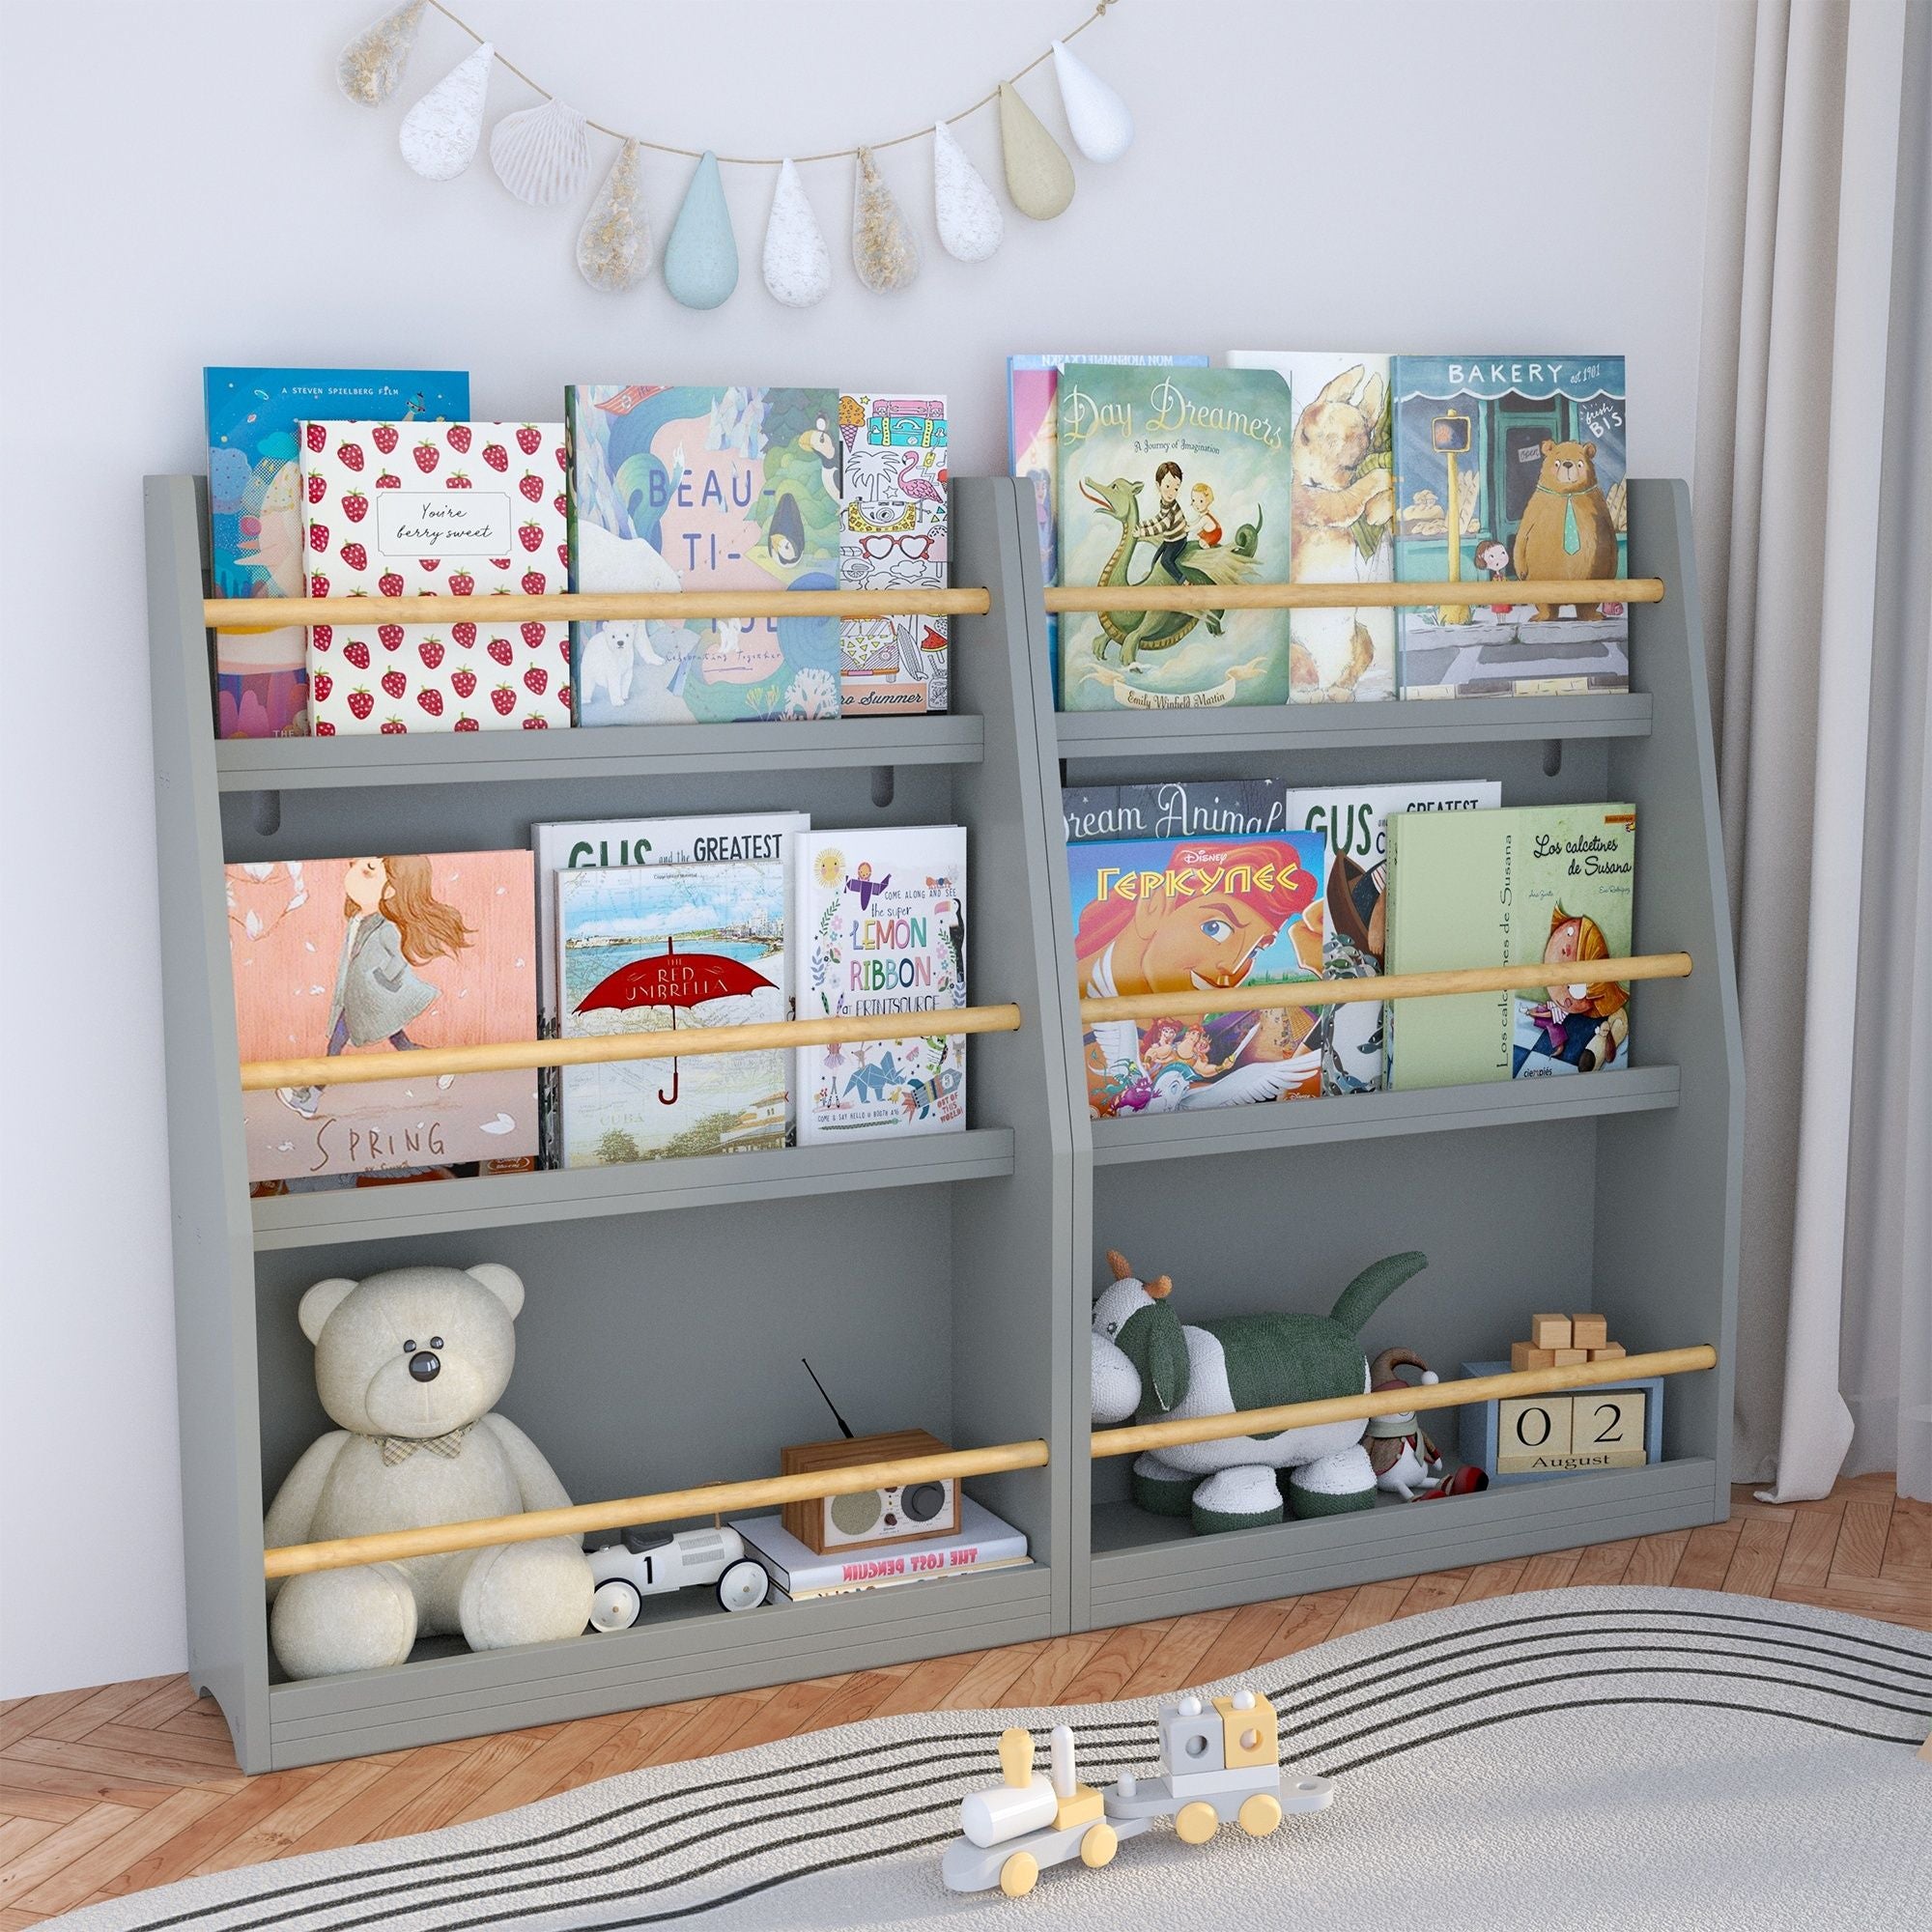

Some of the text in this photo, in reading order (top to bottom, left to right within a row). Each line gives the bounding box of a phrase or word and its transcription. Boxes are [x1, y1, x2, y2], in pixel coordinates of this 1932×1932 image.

[1449, 363, 1563, 384] BAKERY
[292, 386, 324, 395] STEVEN
[327, 386, 374, 396] SPIELBERG
[378, 386, 399, 395] FILM
[1063, 376, 1284, 451] Day Dreamers
[1585, 403, 1614, 425] fresh
[1589, 412, 1624, 440] BIS
[1144, 439, 1171, 453] Journey
[1171, 439, 1179, 449] of
[1180, 439, 1220, 455] Imagination
[648, 469, 776, 507] BEAU-
[396, 525, 494, 546] berry sweet
[682, 532, 741, 572] TI-
[858, 692, 923, 706] Summer
[1127, 691, 1151, 710] Emily
[1193, 693, 1226, 708] Martin
[1064, 783, 1286, 842] ream Animal
[1305, 803, 1374, 857] GUS
[694, 834, 782, 862] GREATEST
[1180, 849, 1228, 865] Disney
[1534, 834, 1619, 859] Los calcetines
[1568, 855, 1633, 876] de Susana
[884, 888, 956, 900] COME ALONG AND SEE
[871, 902, 912, 919] the super
[849, 917, 927, 951] LEMON
[1495, 835, 1513, 1068] Los calcnes de Susana
[658, 967, 695, 982] RED
[850, 955, 931, 992] RIBBON
[625, 979, 729, 1001] UMBRELLA
[309, 1118, 445, 1172] SPRING
[1517, 1404, 1624, 1446] 0 2
[1532, 1454, 1610, 1469] August
[643, 1555, 653, 1584] 1
